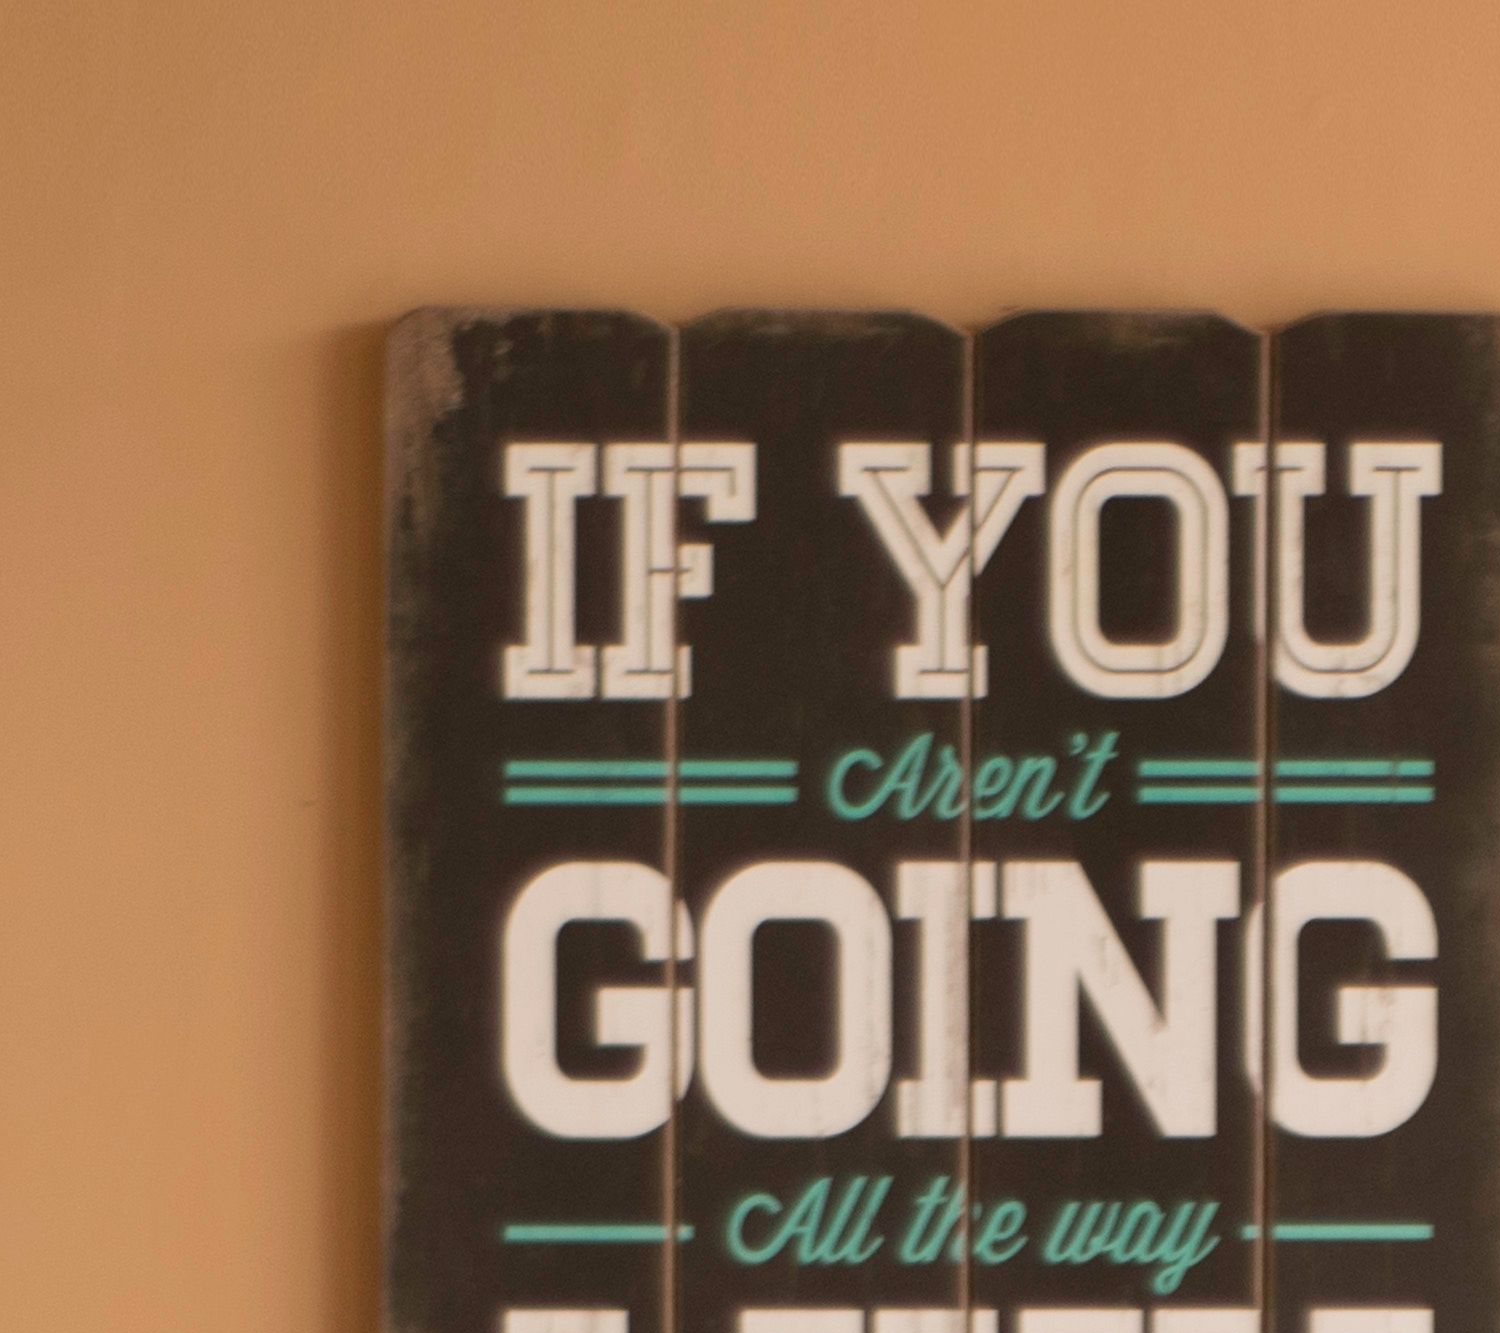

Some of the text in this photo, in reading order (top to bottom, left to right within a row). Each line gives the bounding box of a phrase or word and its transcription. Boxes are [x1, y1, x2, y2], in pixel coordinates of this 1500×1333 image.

[502, 441, 1442, 701] IF YOU
[826, 732, 1119, 825] Aren't
[502, 859, 1439, 1140] GOING
[728, 1174, 894, 1265] All
[1042, 1201, 1219, 1294] way
